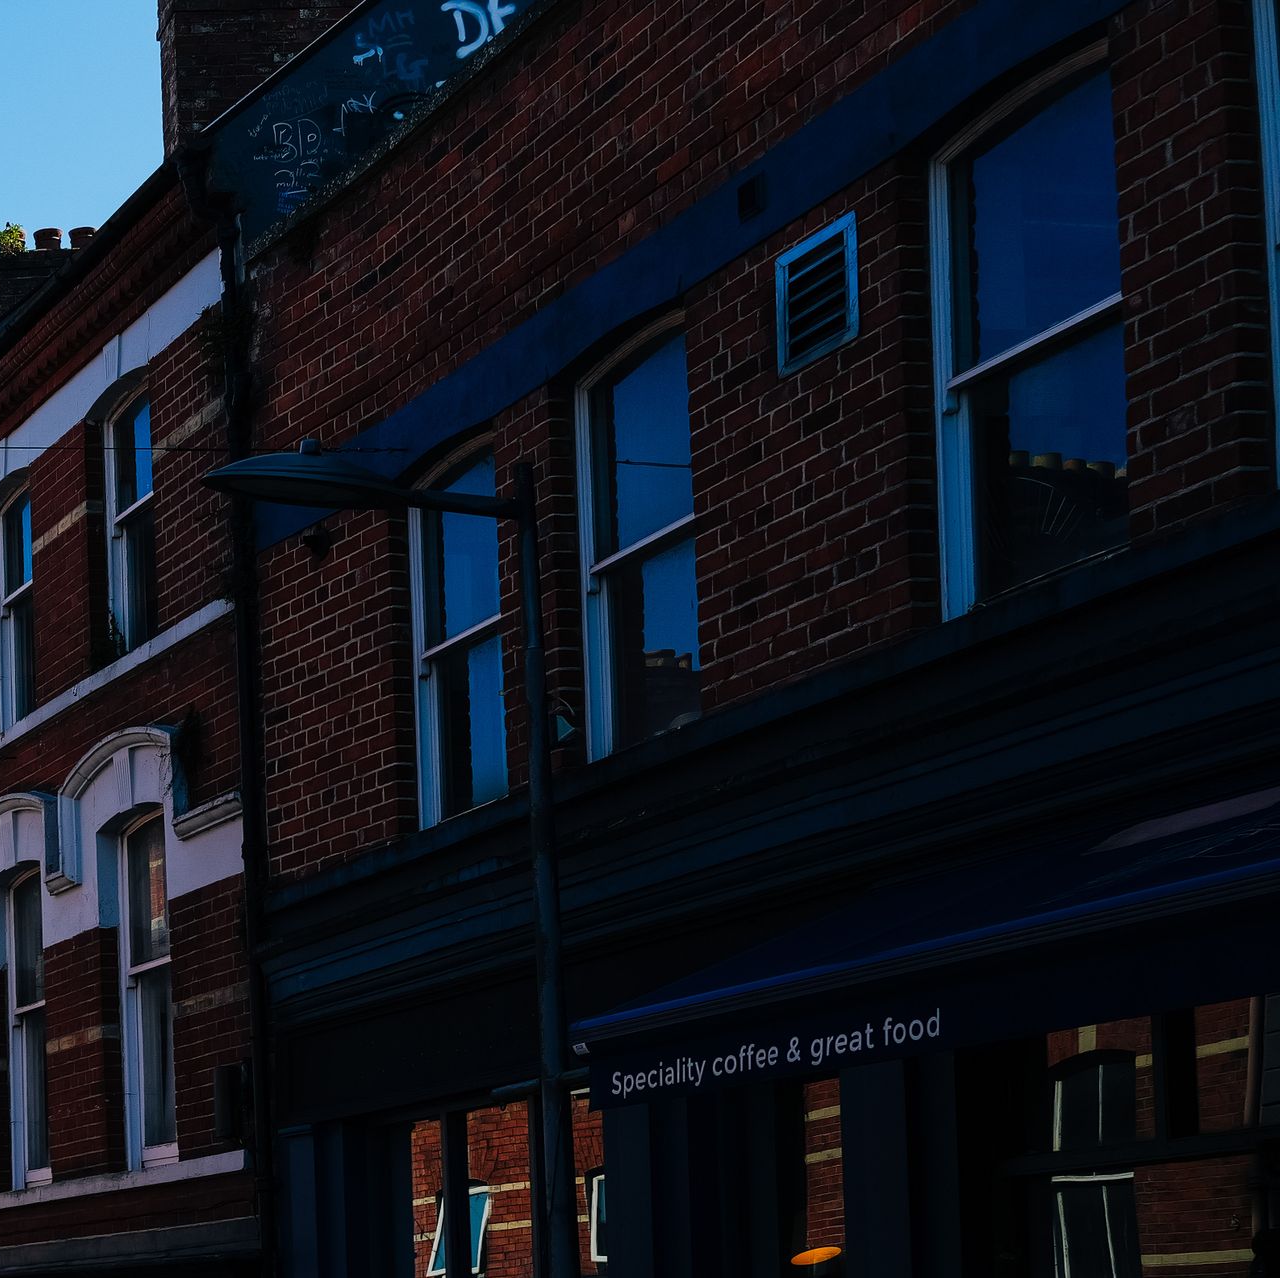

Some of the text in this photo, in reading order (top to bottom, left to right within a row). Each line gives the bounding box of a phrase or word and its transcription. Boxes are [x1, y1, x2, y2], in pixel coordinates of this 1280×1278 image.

[610, 1007, 941, 1100] Speciality coffee & great food
